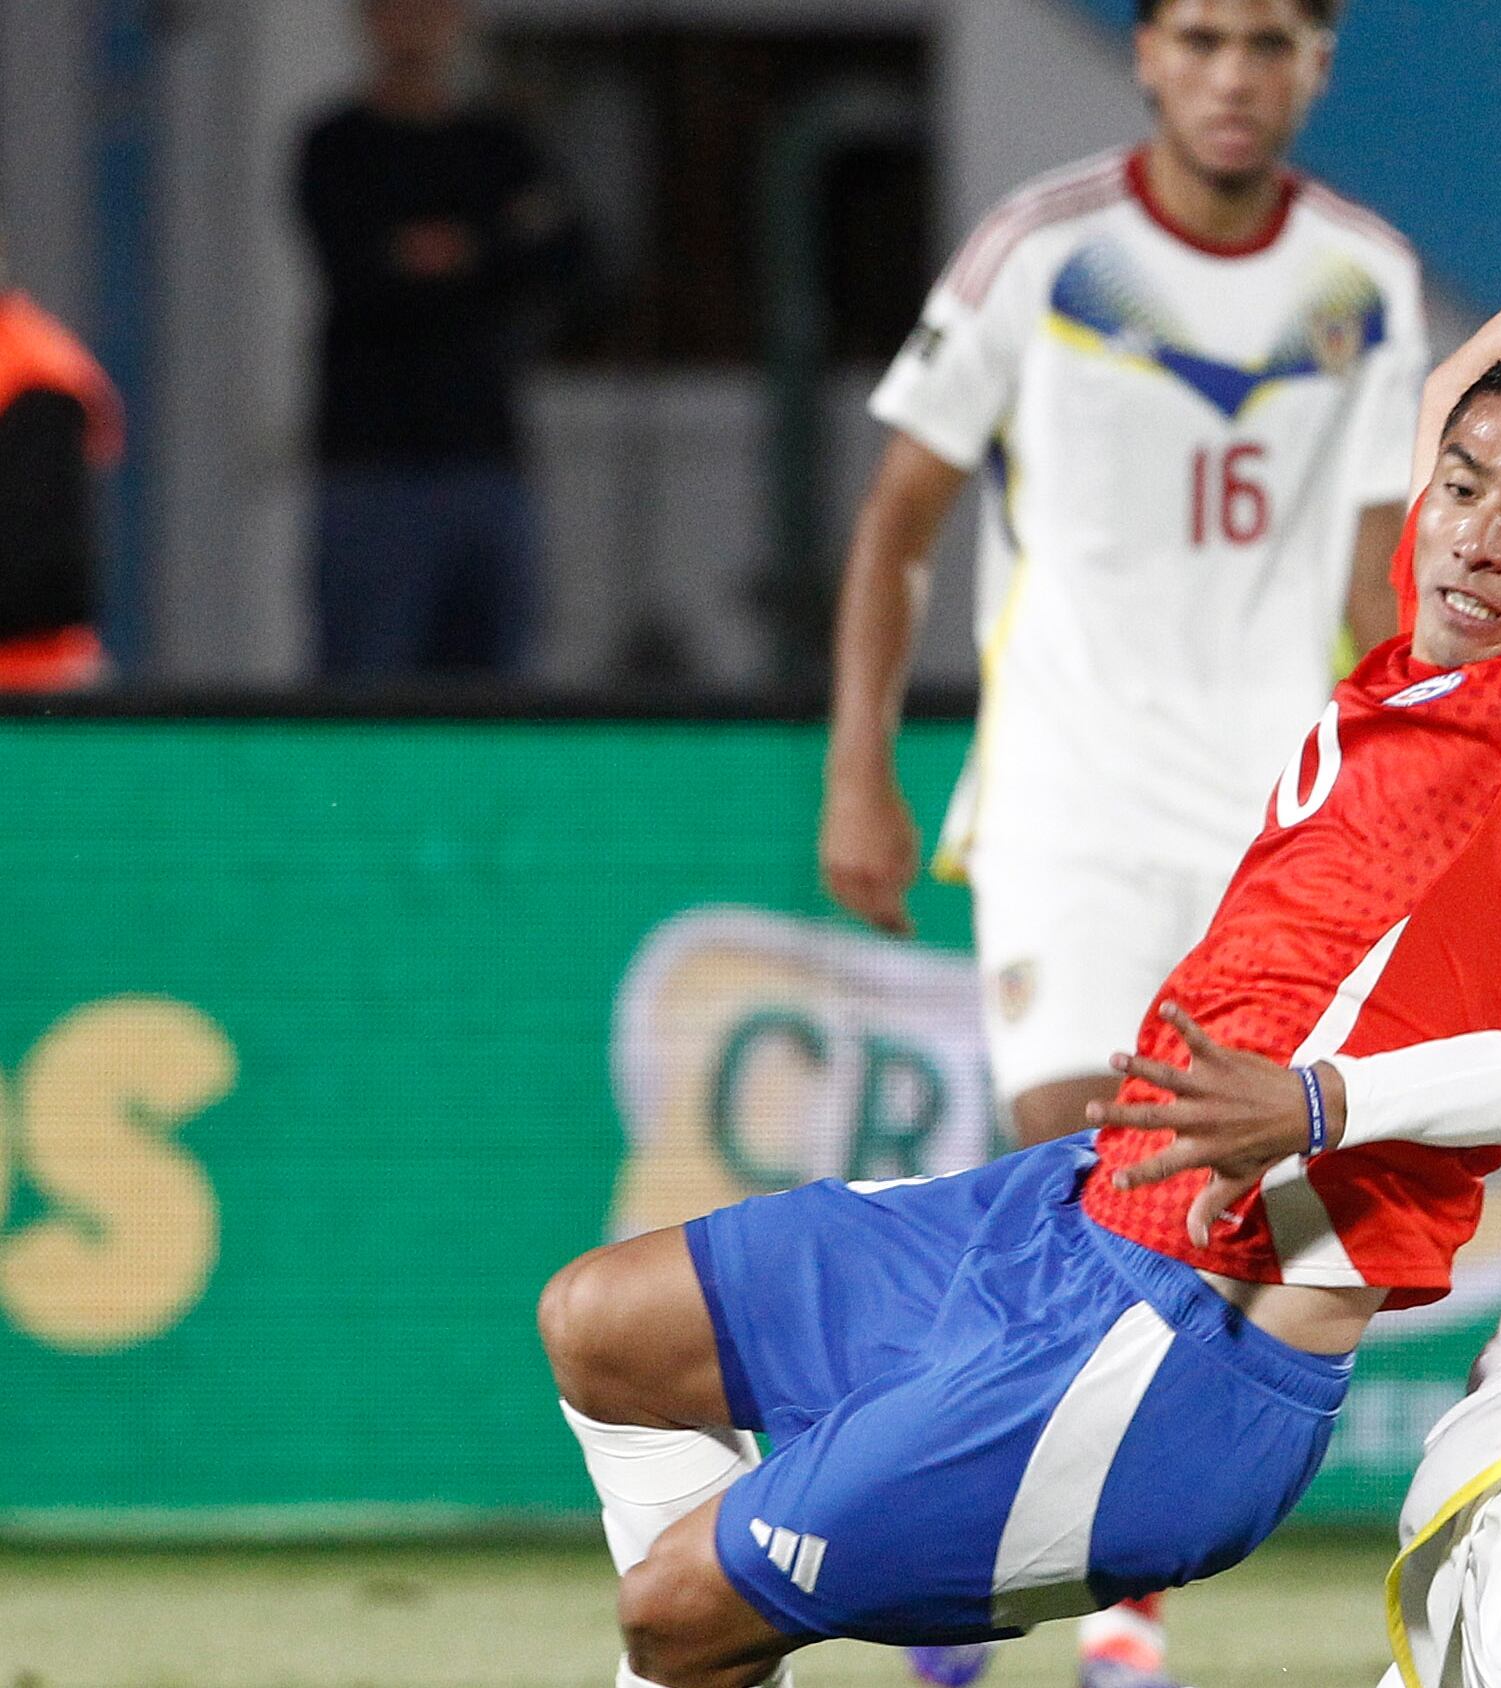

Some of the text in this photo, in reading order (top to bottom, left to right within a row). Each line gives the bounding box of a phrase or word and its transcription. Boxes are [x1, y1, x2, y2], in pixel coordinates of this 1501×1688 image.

[1190, 442, 1270, 549] 16
[0, 990, 242, 1355] S
[706, 1003, 1006, 1196] CR
